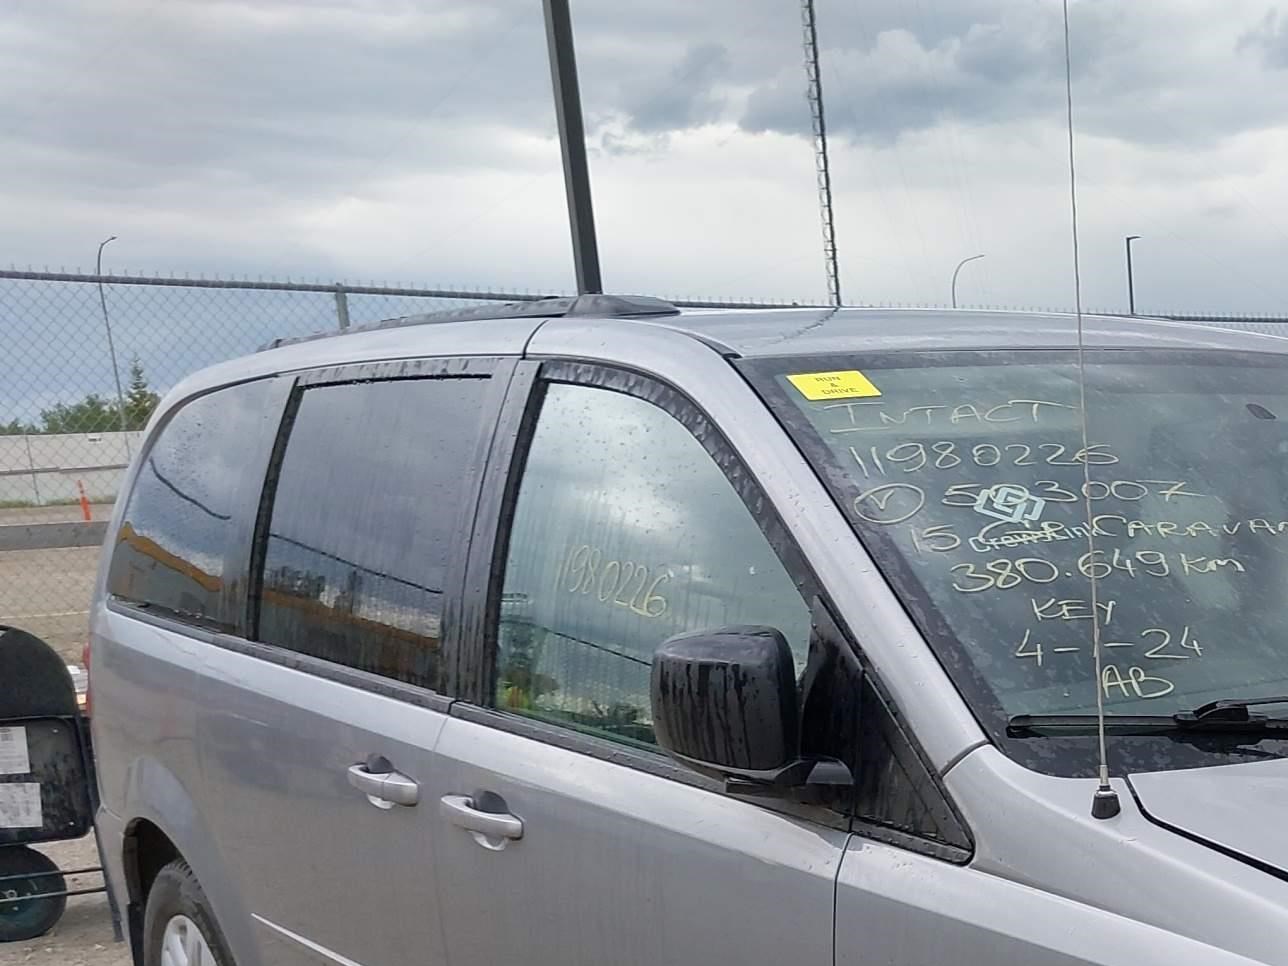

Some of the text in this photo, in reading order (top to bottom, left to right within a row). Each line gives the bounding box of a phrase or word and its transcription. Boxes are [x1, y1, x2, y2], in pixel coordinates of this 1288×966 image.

[821, 387, 860, 395] DRIVE
[824, 401, 1077, 432] INTACT
[849, 441, 1119, 478] 11980226
[909, 524, 961, 553] 15
[1032, 598, 1116, 625] KEY
